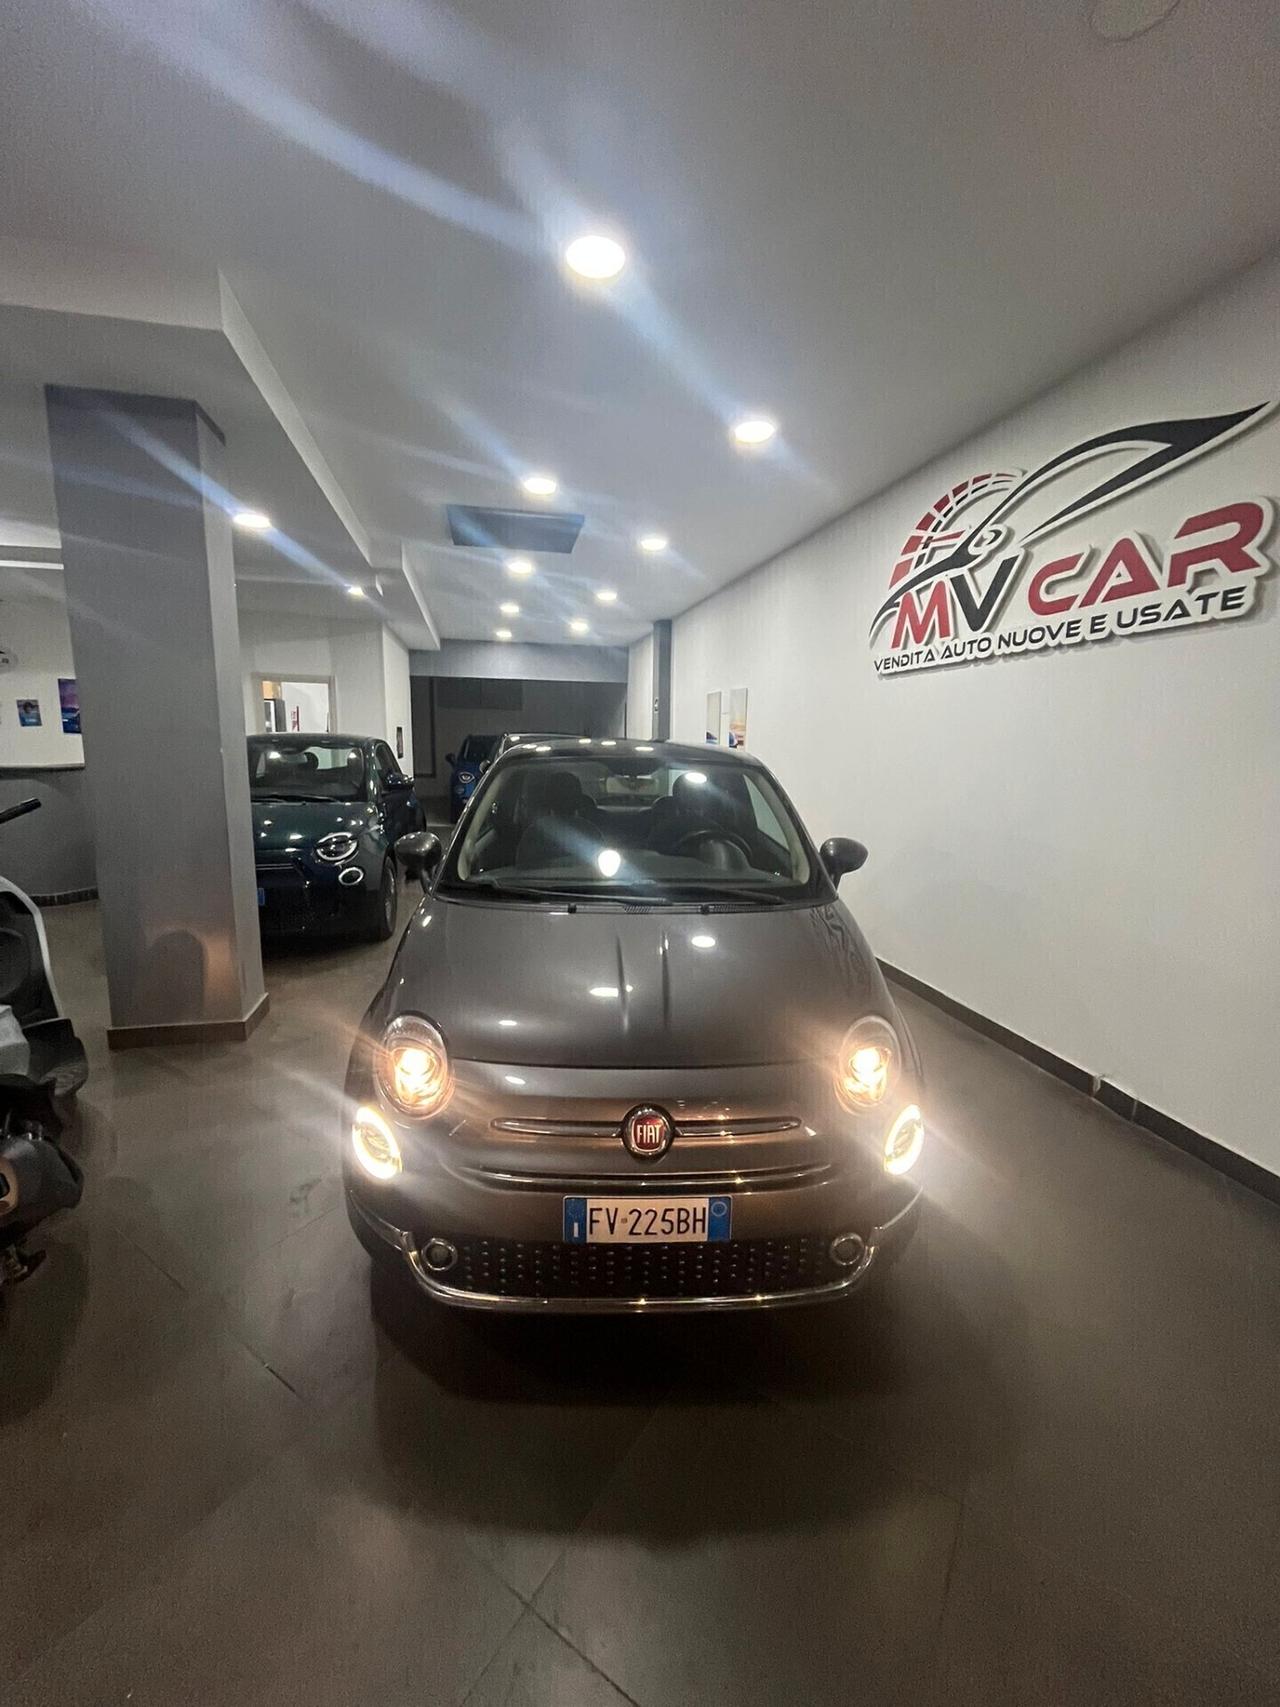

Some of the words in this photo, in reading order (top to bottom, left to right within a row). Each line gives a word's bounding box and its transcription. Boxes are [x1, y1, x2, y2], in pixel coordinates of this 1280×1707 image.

[891, 556, 1019, 649] MV
[1027, 502, 1263, 616] CAR
[874, 650, 936, 671] VENDITA
[940, 637, 991, 659] AUTO
[998, 619, 1082, 648] NUOVE
[1089, 615, 1106, 634] E
[1115, 587, 1246, 627] USATE
[636, 1124, 662, 1143] FIAT
